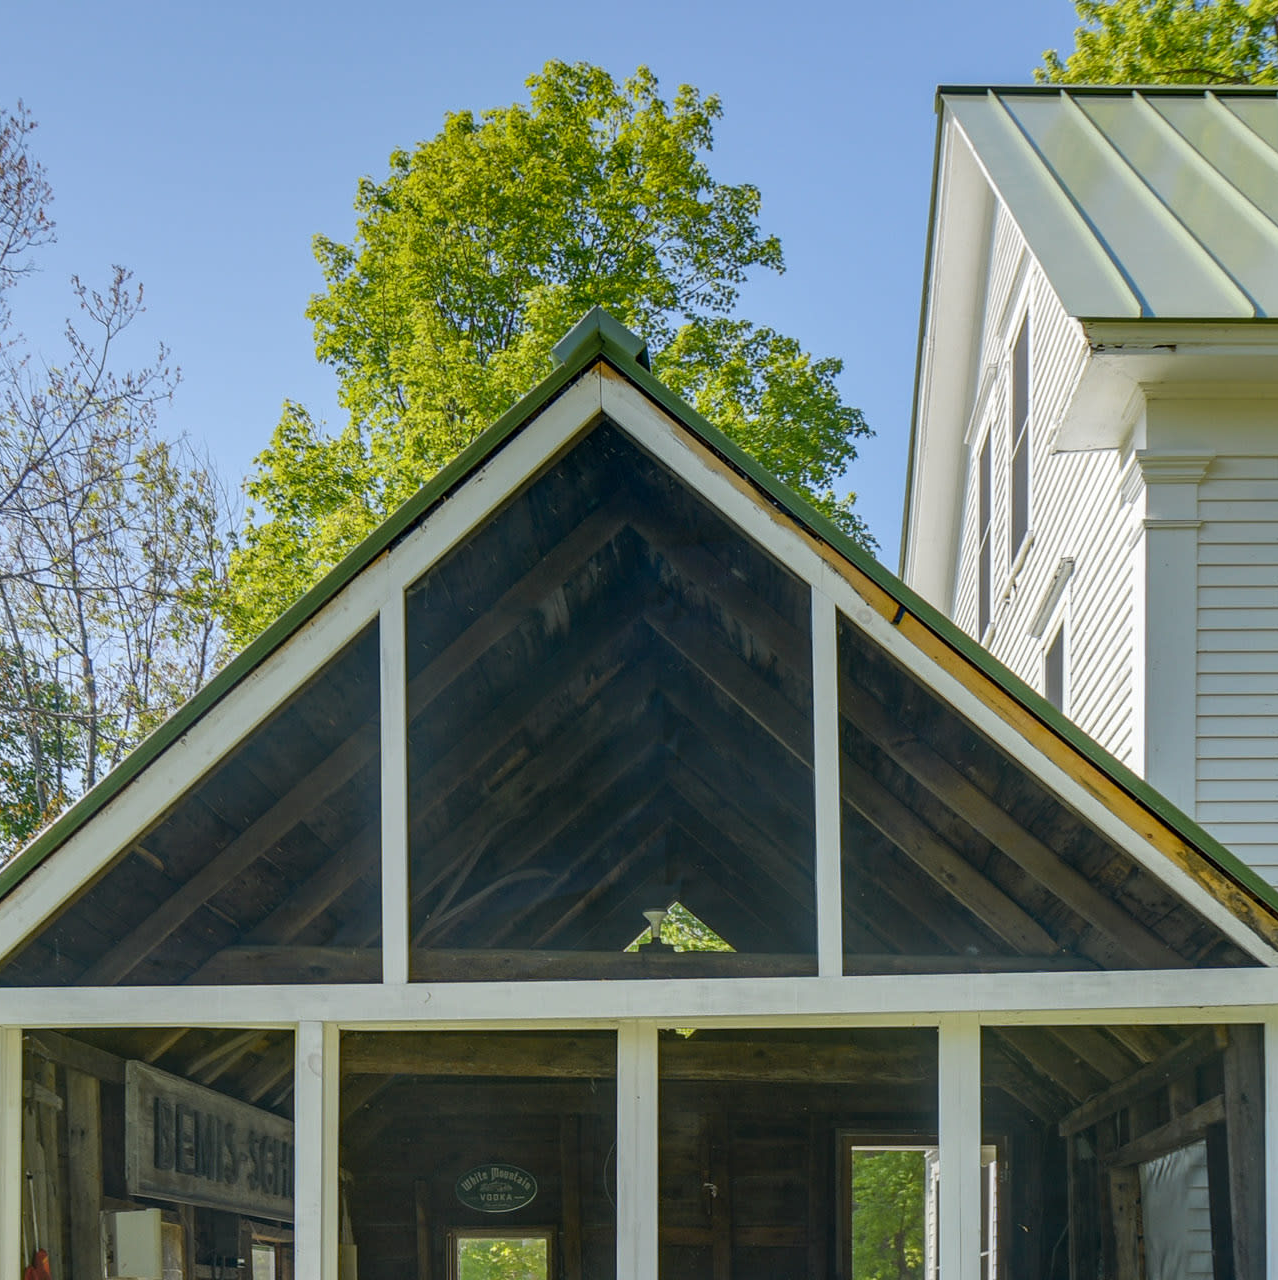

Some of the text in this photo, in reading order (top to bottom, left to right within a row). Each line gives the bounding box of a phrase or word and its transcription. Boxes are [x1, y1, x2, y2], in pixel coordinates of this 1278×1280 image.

[461, 1167, 531, 1192] White Mountain
[480, 1193, 513, 1201] VODKA
